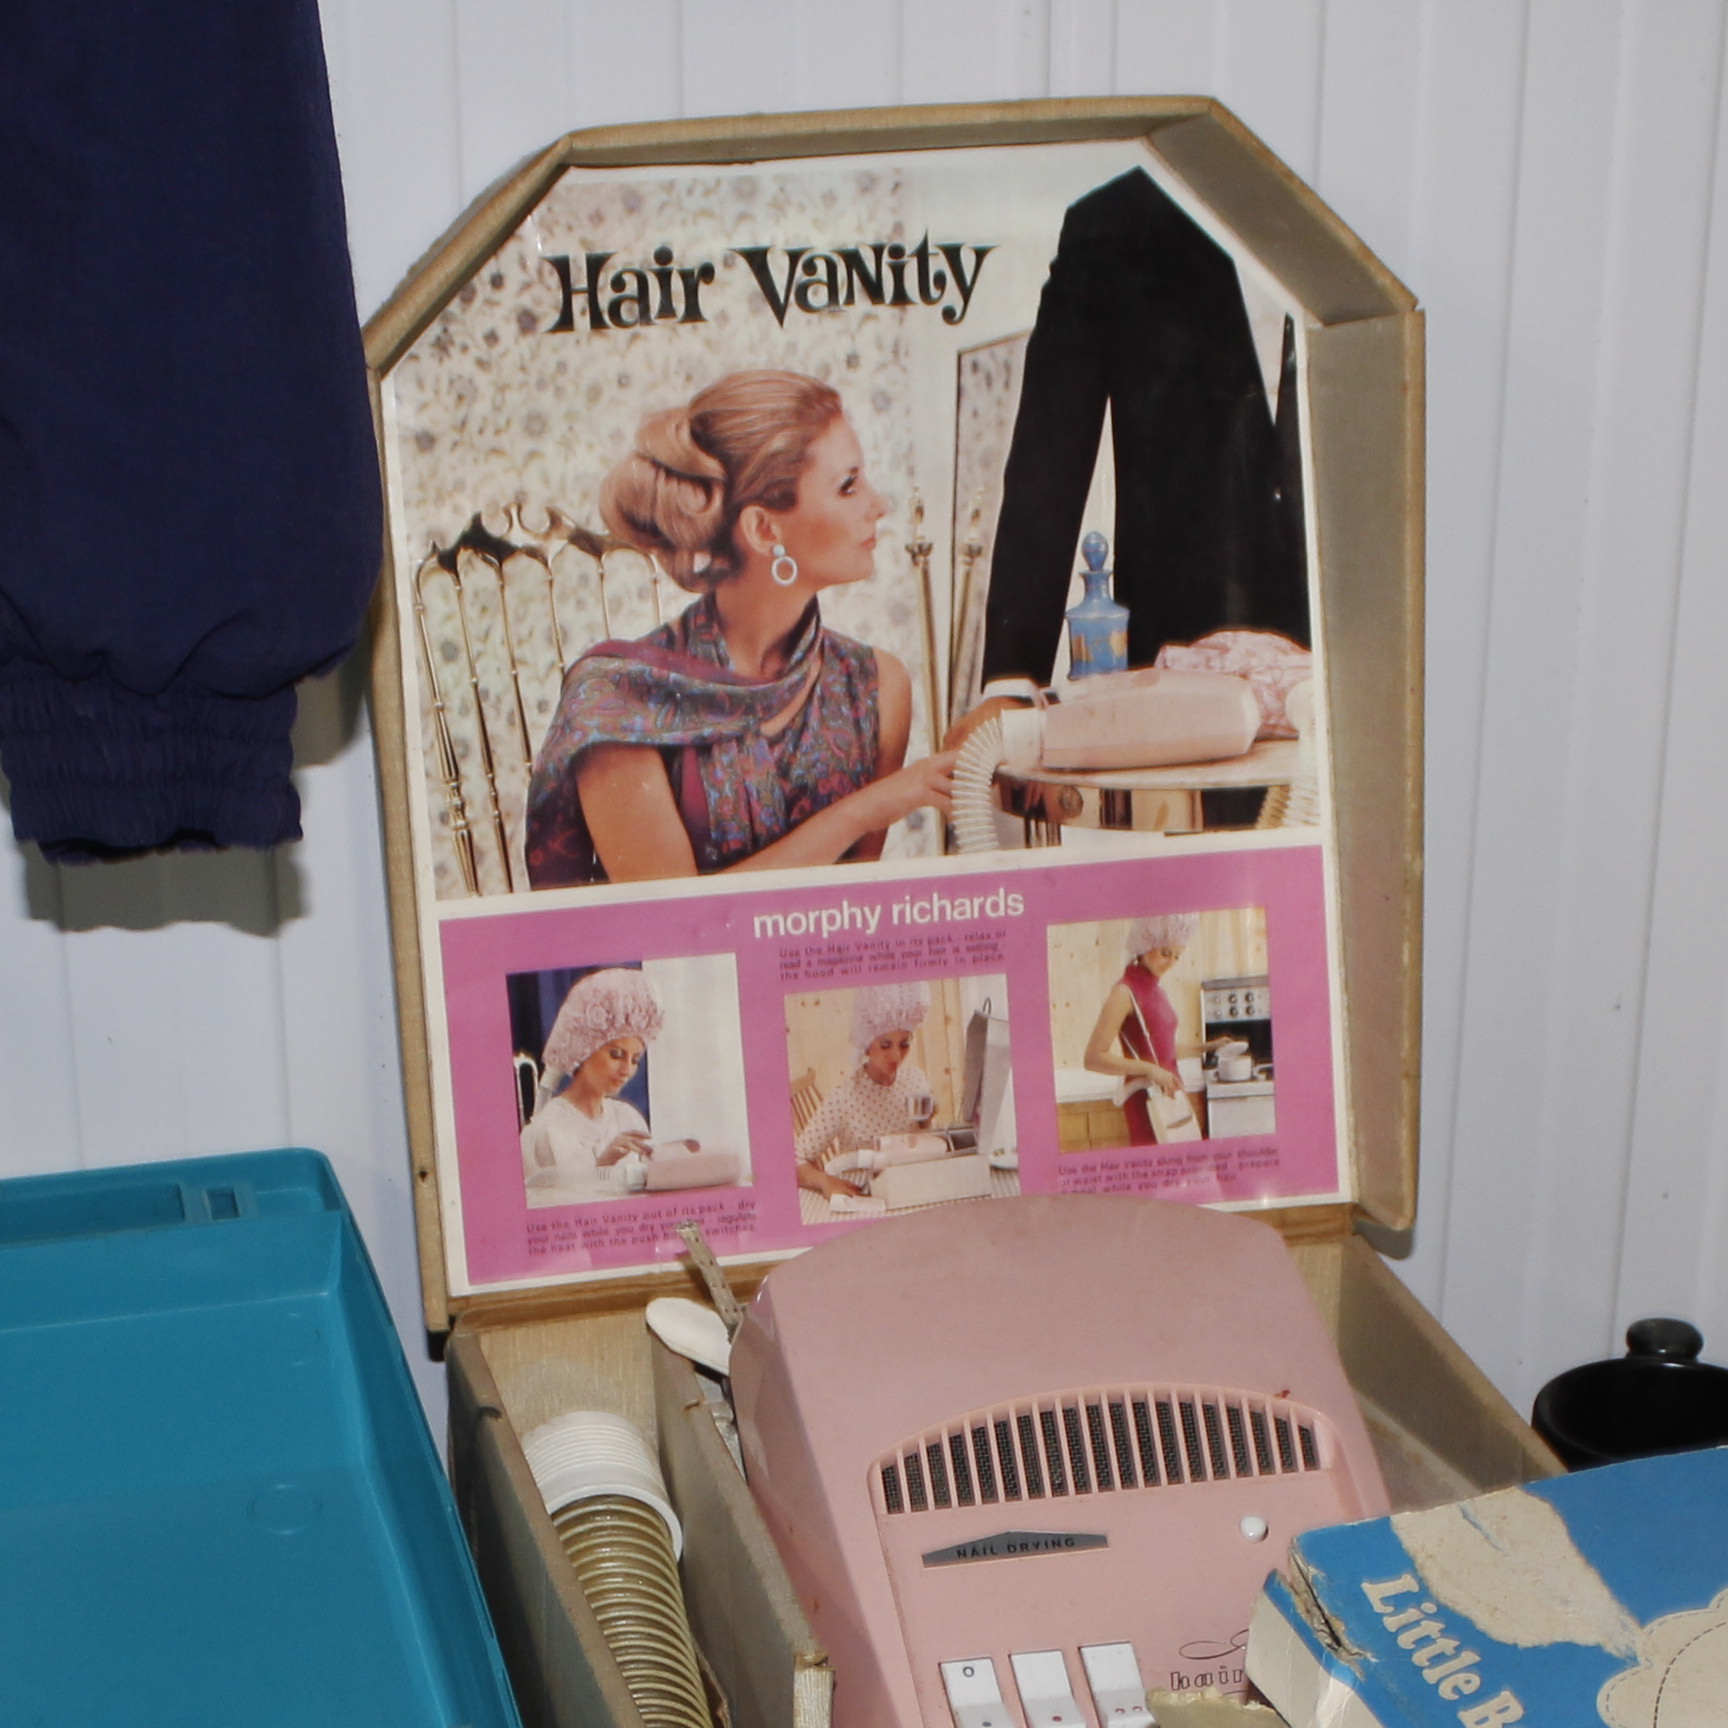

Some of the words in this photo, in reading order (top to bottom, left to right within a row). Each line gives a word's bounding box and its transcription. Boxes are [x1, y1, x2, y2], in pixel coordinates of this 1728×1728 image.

[540, 246, 715, 333] Hair
[753, 900, 882, 938] morphy
[892, 888, 1024, 924] richards
[805, 946, 822, 954] the
[828, 944, 850, 954] Hair
[804, 968, 834, 978] hood
[841, 964, 862, 975] will
[868, 961, 908, 972] remain
[552, 1221, 568, 1230] the
[575, 1218, 596, 1227] Hair
[602, 1213, 637, 1225] Vanity
[642, 1212, 661, 1220] out
[698, 1203, 724, 1215] pack
[738, 1201, 755, 1211] dry
[956, 1546, 998, 1558] NAIL
[1007, 1538, 1075, 1553] DRYING
[1361, 1573, 1481, 1701] Little
